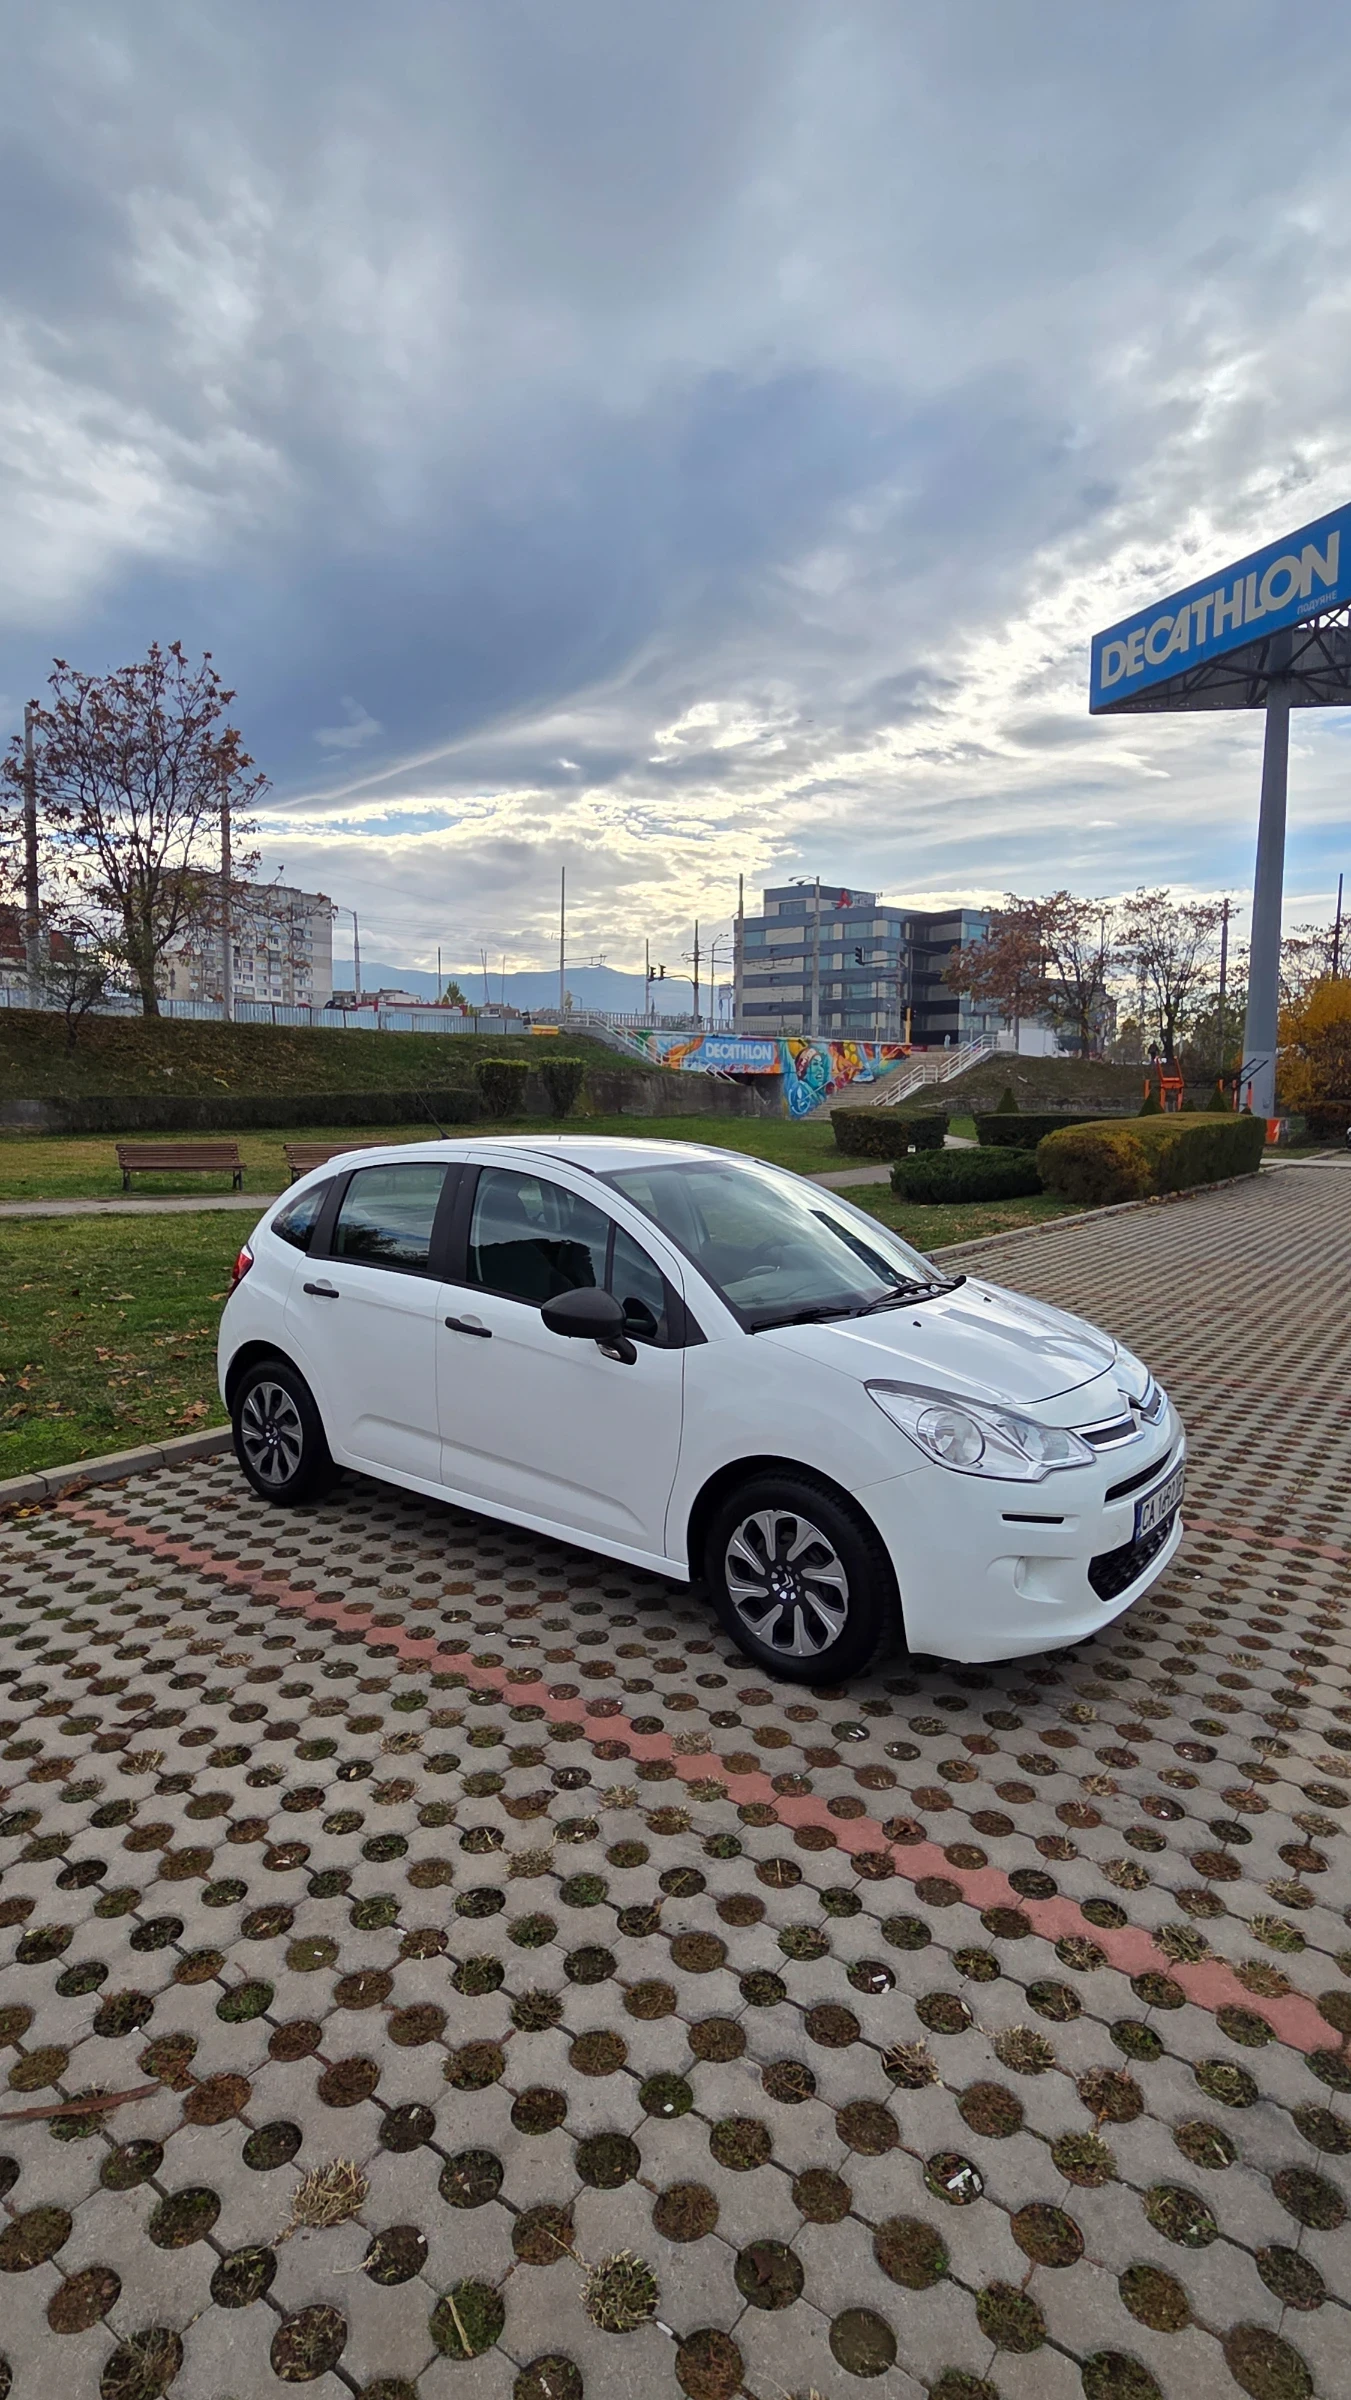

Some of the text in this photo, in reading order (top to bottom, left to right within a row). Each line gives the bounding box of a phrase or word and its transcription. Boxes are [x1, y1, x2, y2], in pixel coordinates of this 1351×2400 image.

[1101, 530, 1340, 689] DECATHLON
[1297, 590, 1338, 615] ПОДУЯНЕ
[705, 1043, 772, 1060] DECATHLON
